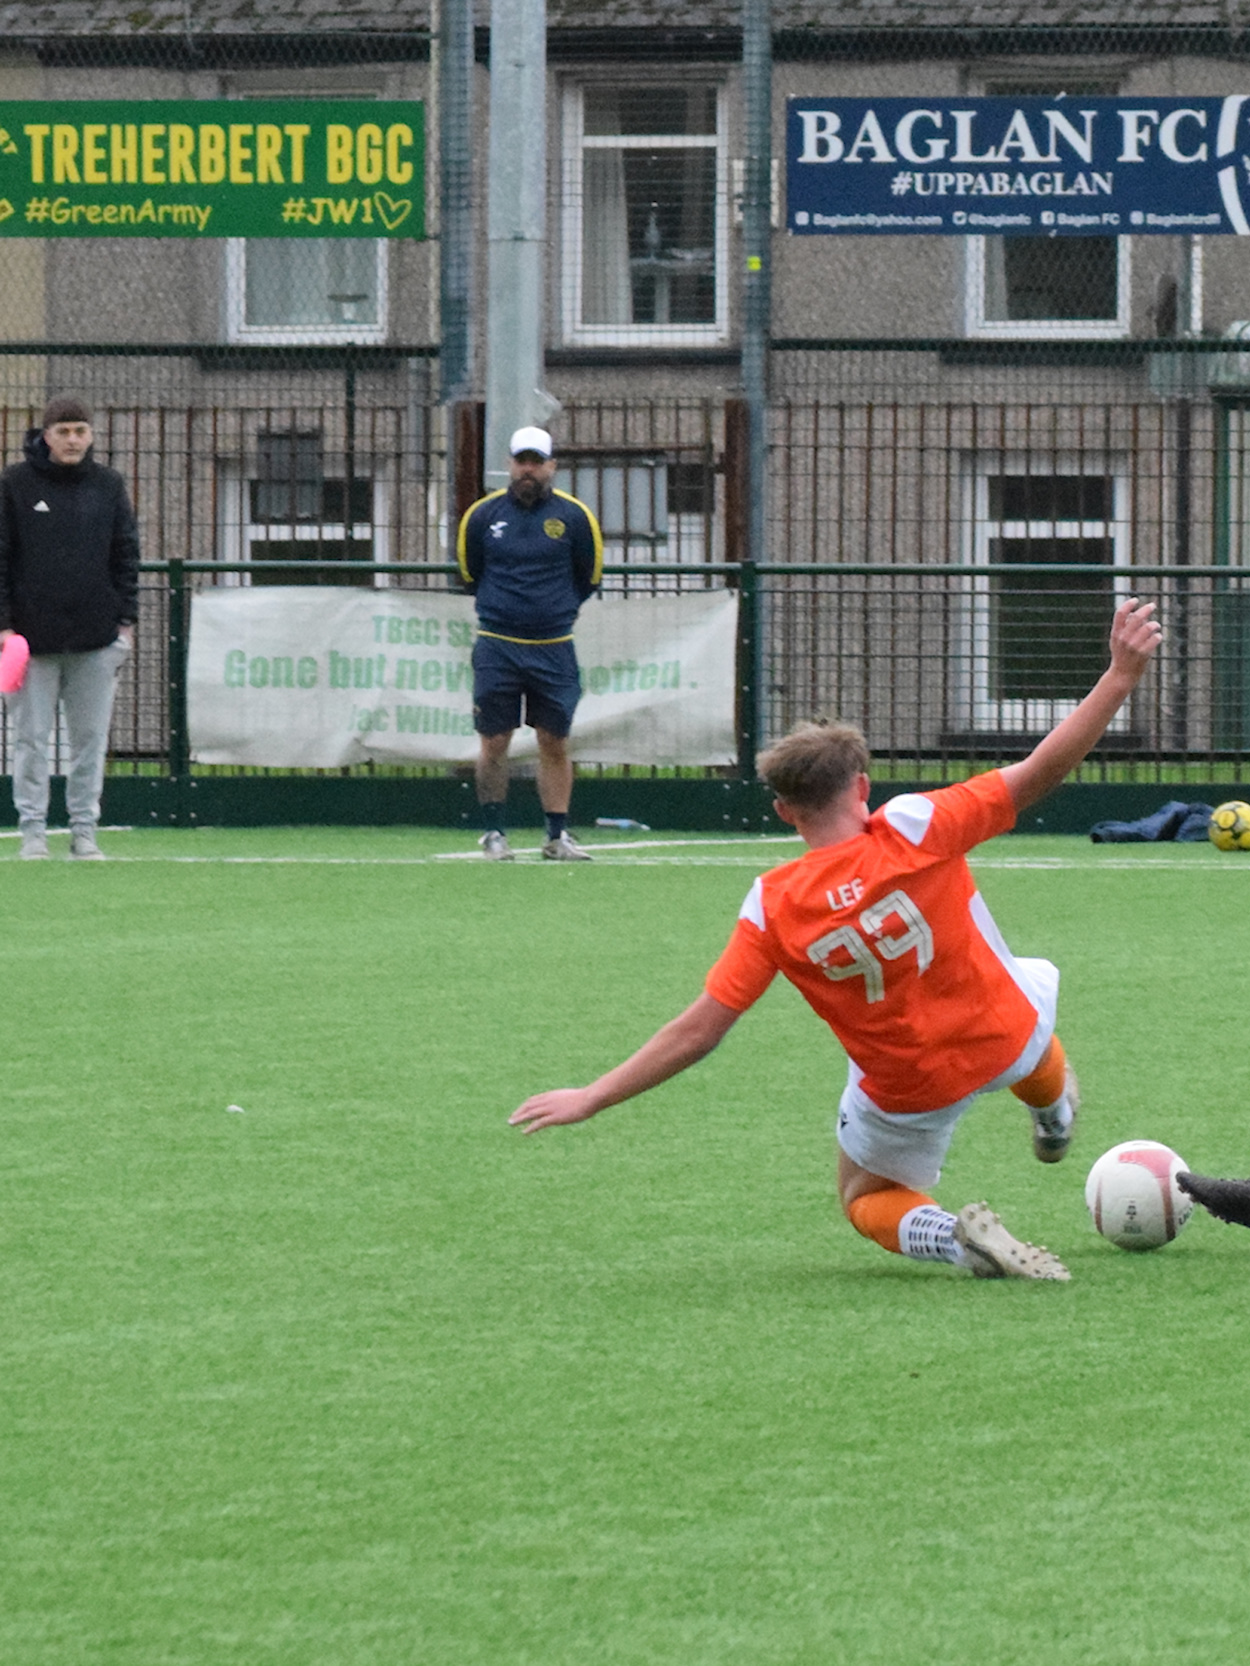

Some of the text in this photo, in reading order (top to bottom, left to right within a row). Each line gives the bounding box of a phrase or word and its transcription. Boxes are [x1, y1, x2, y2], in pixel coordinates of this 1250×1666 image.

[24, 123, 414, 184] TREHERBERT BGC
[797, 108, 1208, 164] BAGLAN FC
[890, 171, 1114, 197] #UPPABAGLAN
[25, 197, 213, 232] #GreenArmy
[1102, 211, 1121, 226] FC
[371, 615, 441, 647] TBGC
[224, 648, 319, 691] Gone
[329, 650, 388, 690] but
[395, 657, 475, 694] nev
[806, 889, 935, 1005] 99
